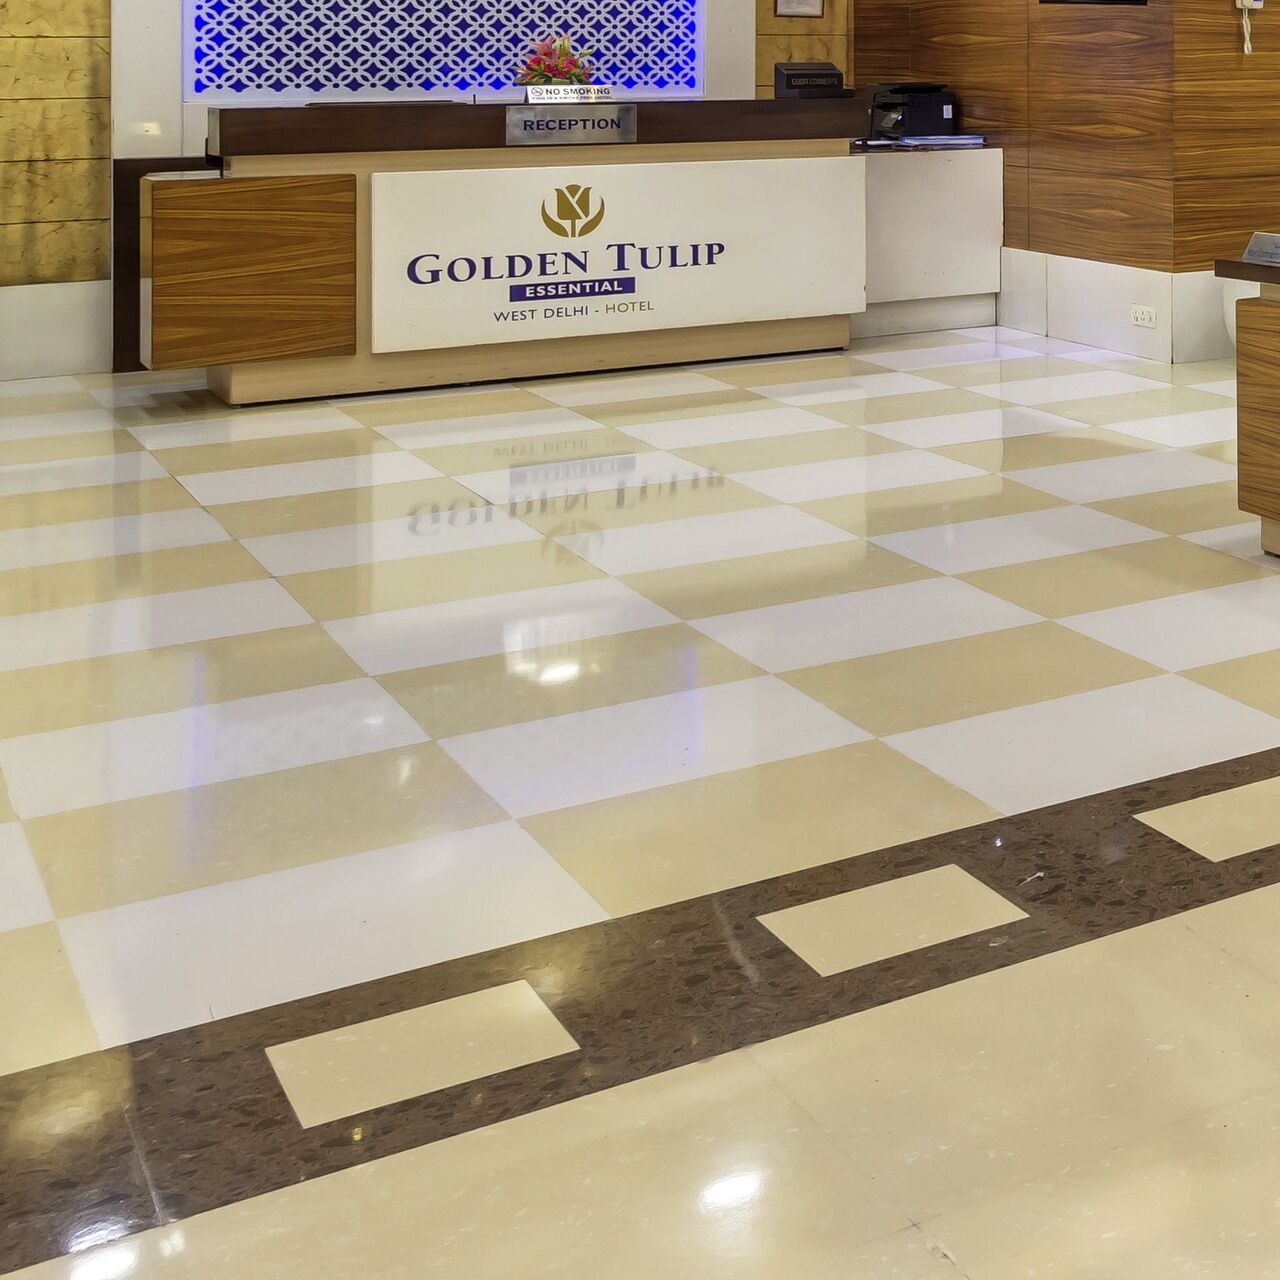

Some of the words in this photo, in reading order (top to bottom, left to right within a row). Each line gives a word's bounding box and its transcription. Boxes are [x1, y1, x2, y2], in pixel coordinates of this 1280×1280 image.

[545, 88, 560, 96] NO
[563, 87, 611, 96] SMOKING
[523, 117, 622, 131] RECEPTION
[406, 250, 589, 285] GOLDEN
[605, 242, 726, 272] TULIP
[525, 280, 623, 299] ESSENTIAL
[493, 308, 538, 323] WEST
[543, 305, 589, 320] DELHI
[605, 300, 655, 315] HOTEL
